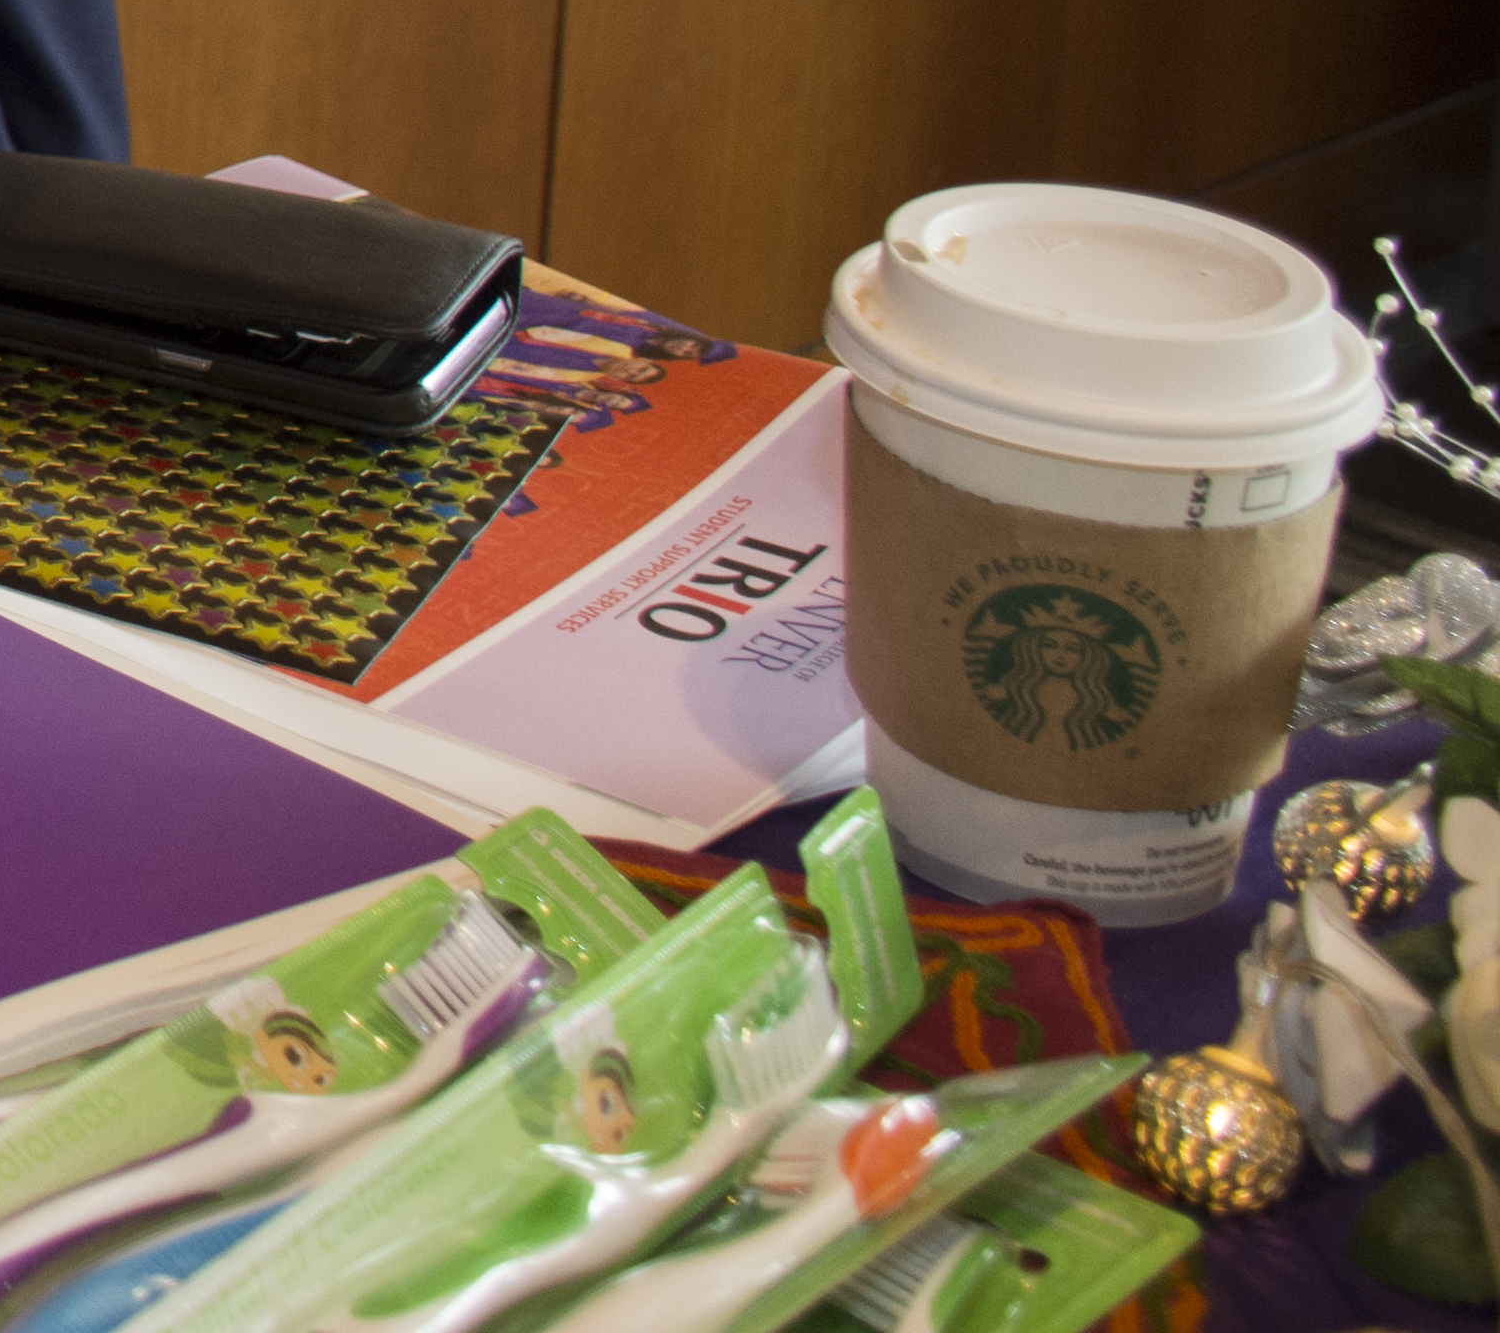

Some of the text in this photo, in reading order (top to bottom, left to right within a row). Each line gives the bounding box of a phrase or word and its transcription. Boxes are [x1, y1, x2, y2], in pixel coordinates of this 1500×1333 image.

[555, 495, 753, 634] STUDENT SUPPORT SERVICES
[636, 535, 830, 643] TRIO
[941, 553, 1189, 646] WE PROUDLY SERVE
[720, 576, 847, 673] NVER
